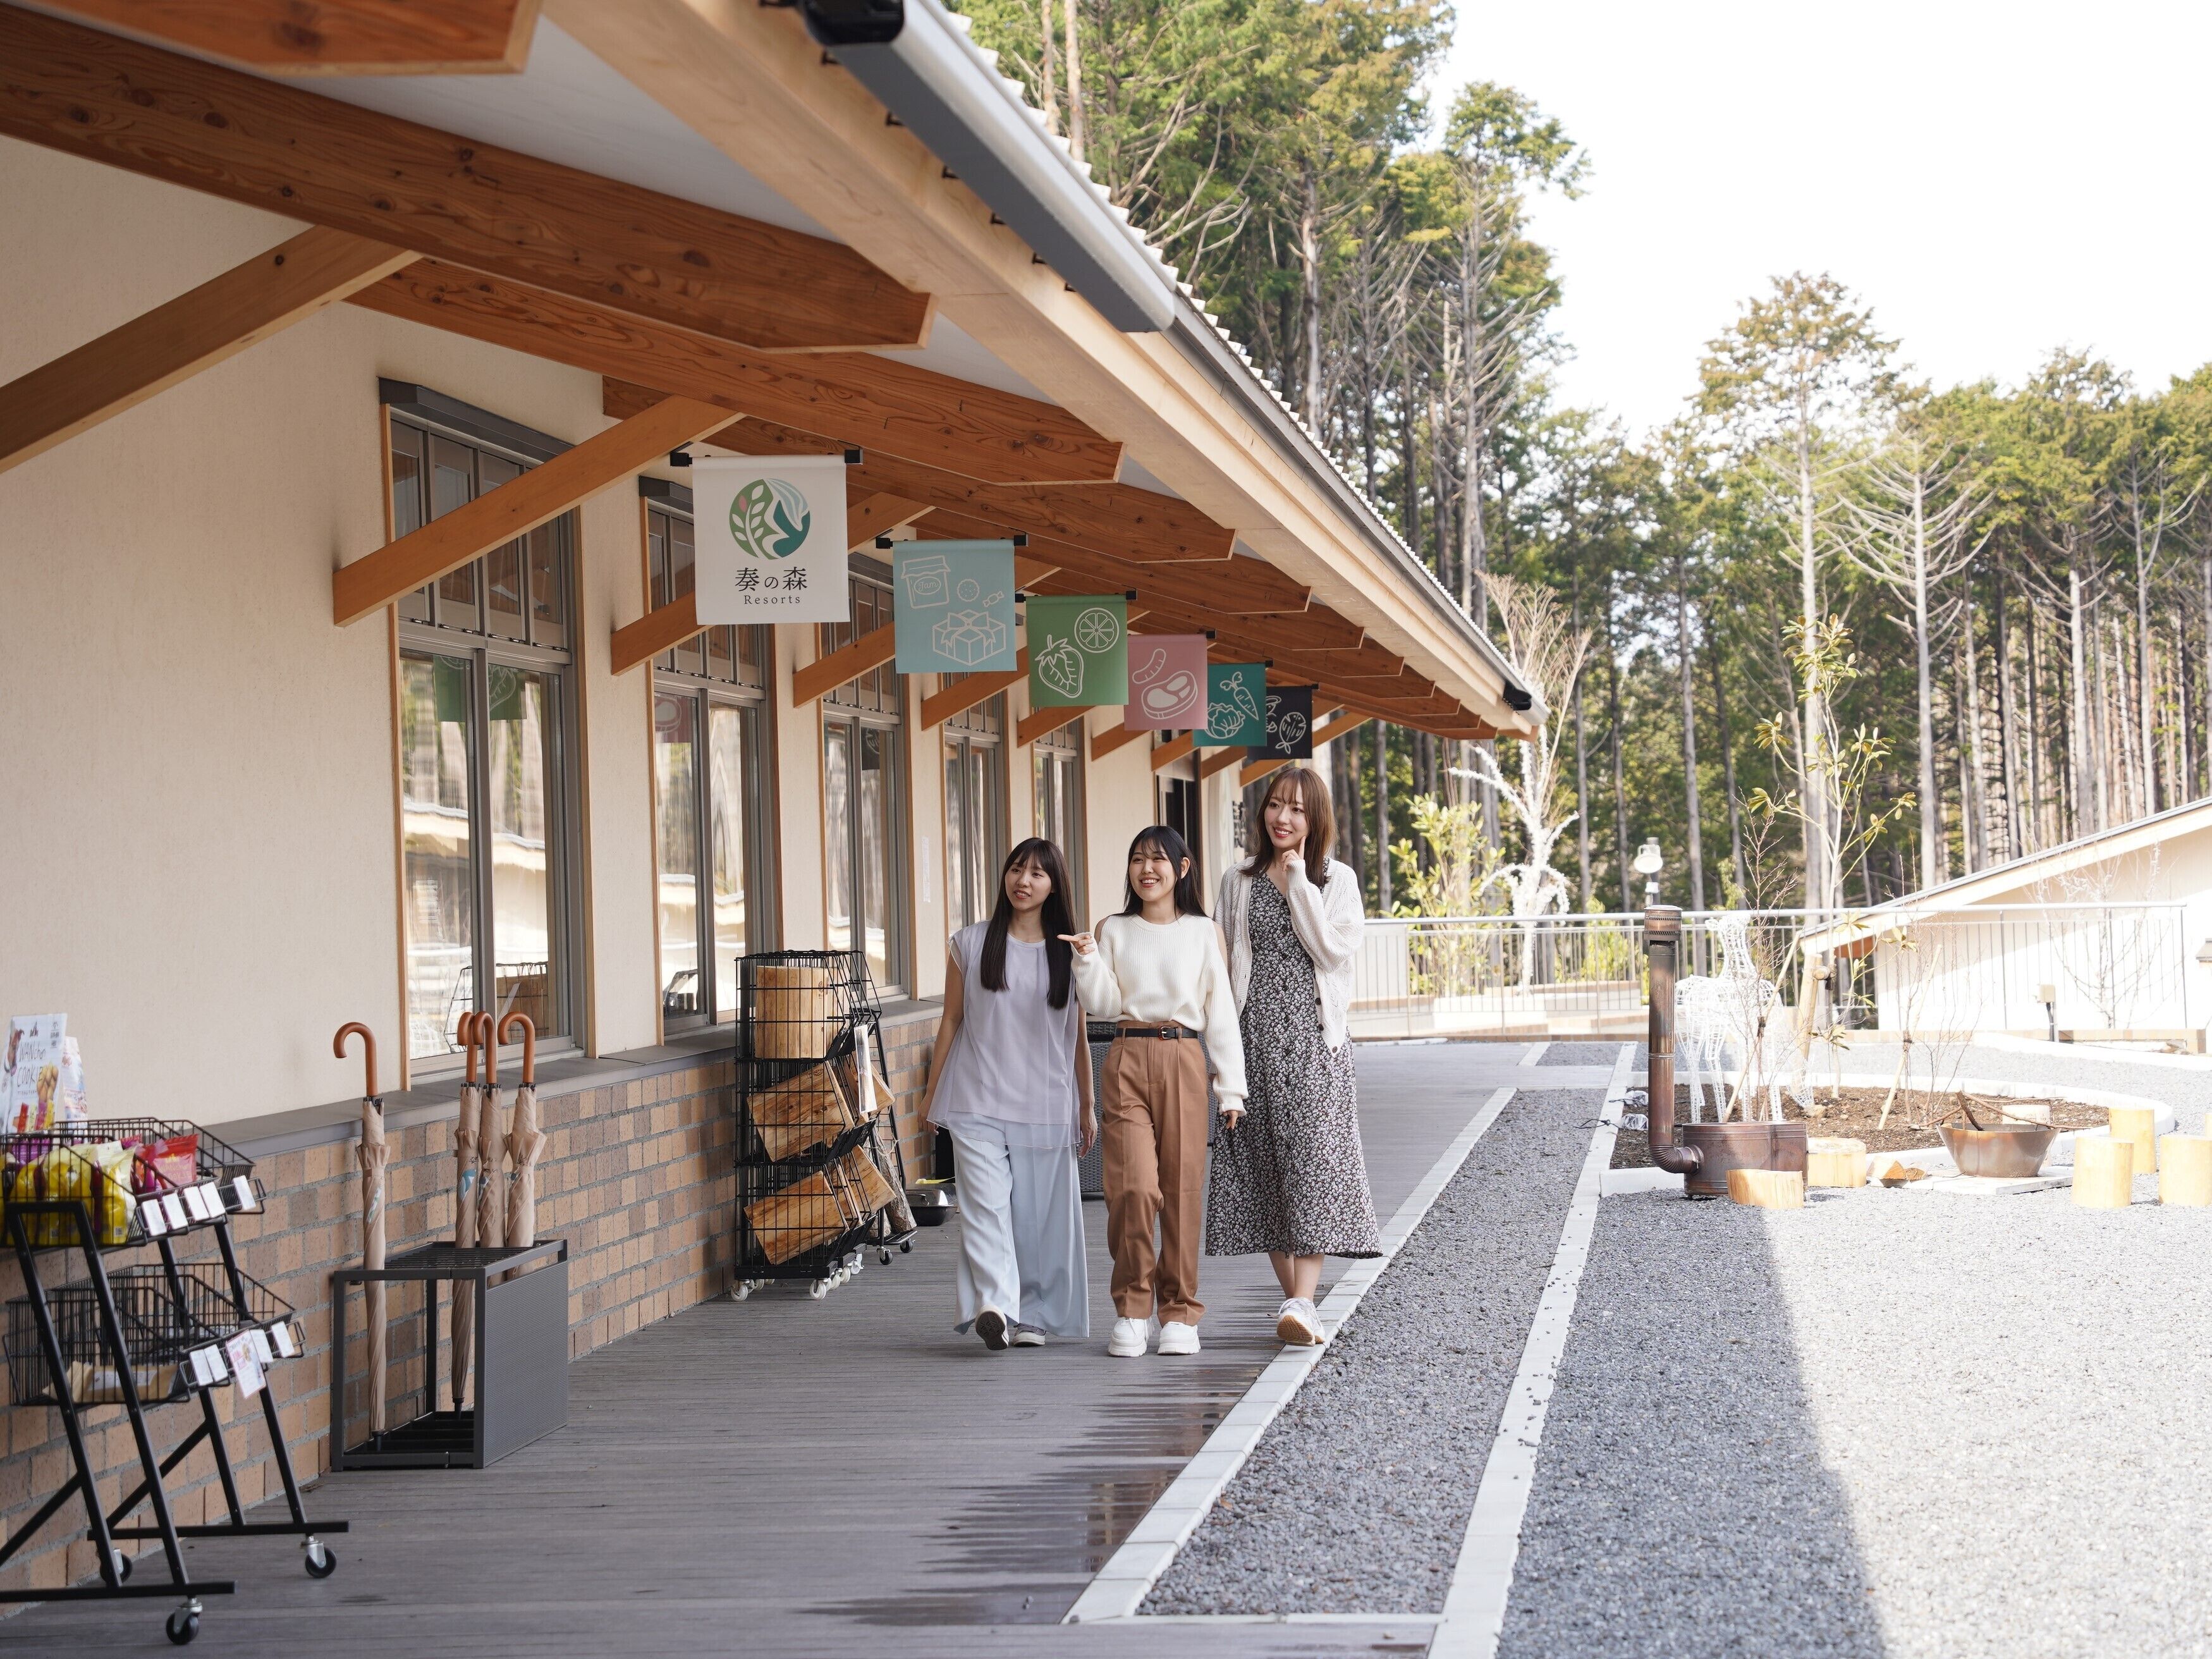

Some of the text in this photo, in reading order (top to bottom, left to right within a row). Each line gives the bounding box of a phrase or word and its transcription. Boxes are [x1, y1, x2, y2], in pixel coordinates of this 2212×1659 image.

[735, 566, 807, 591] 奏の森
[918, 581, 938, 592] Jam
[744, 595, 800, 604] Resorts
[17, 1064, 43, 1087] COOKIE
